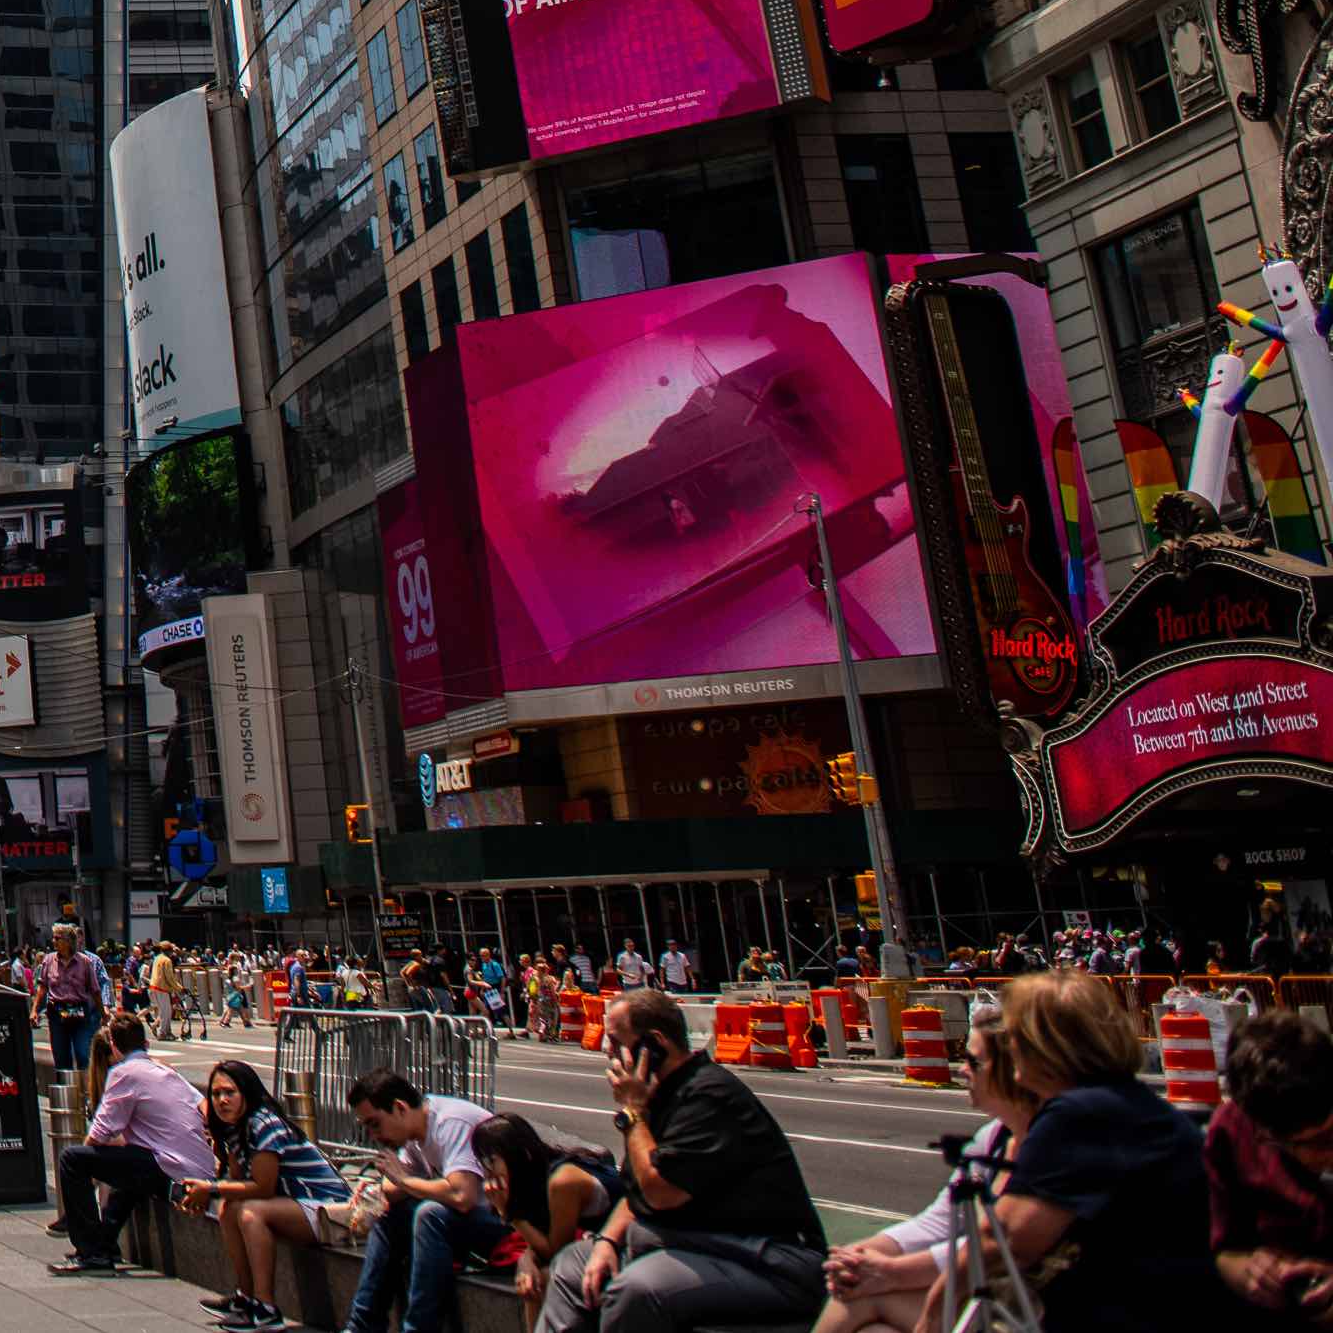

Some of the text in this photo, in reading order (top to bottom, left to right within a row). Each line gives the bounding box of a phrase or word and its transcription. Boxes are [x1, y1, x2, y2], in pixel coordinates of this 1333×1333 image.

[135, 232, 166, 282] all.
[134, 344, 177, 403] slack
[396, 554, 436, 645] 99
[1156, 592, 1271, 645] Hard Rock
[161, 622, 193, 643] CHASE
[991, 629, 1078, 666] Hard Rock
[232, 633, 257, 784] THOMSON REUTERS
[666, 678, 795, 700] THOMSON REUTERS
[1127, 680, 1309, 728] Located on West 42nd Street
[1133, 711, 1319, 755] Between 7th and 8th Avenues
[435, 758, 475, 794] AT&T
[1244, 848, 1307, 865] ROCK SHOP
